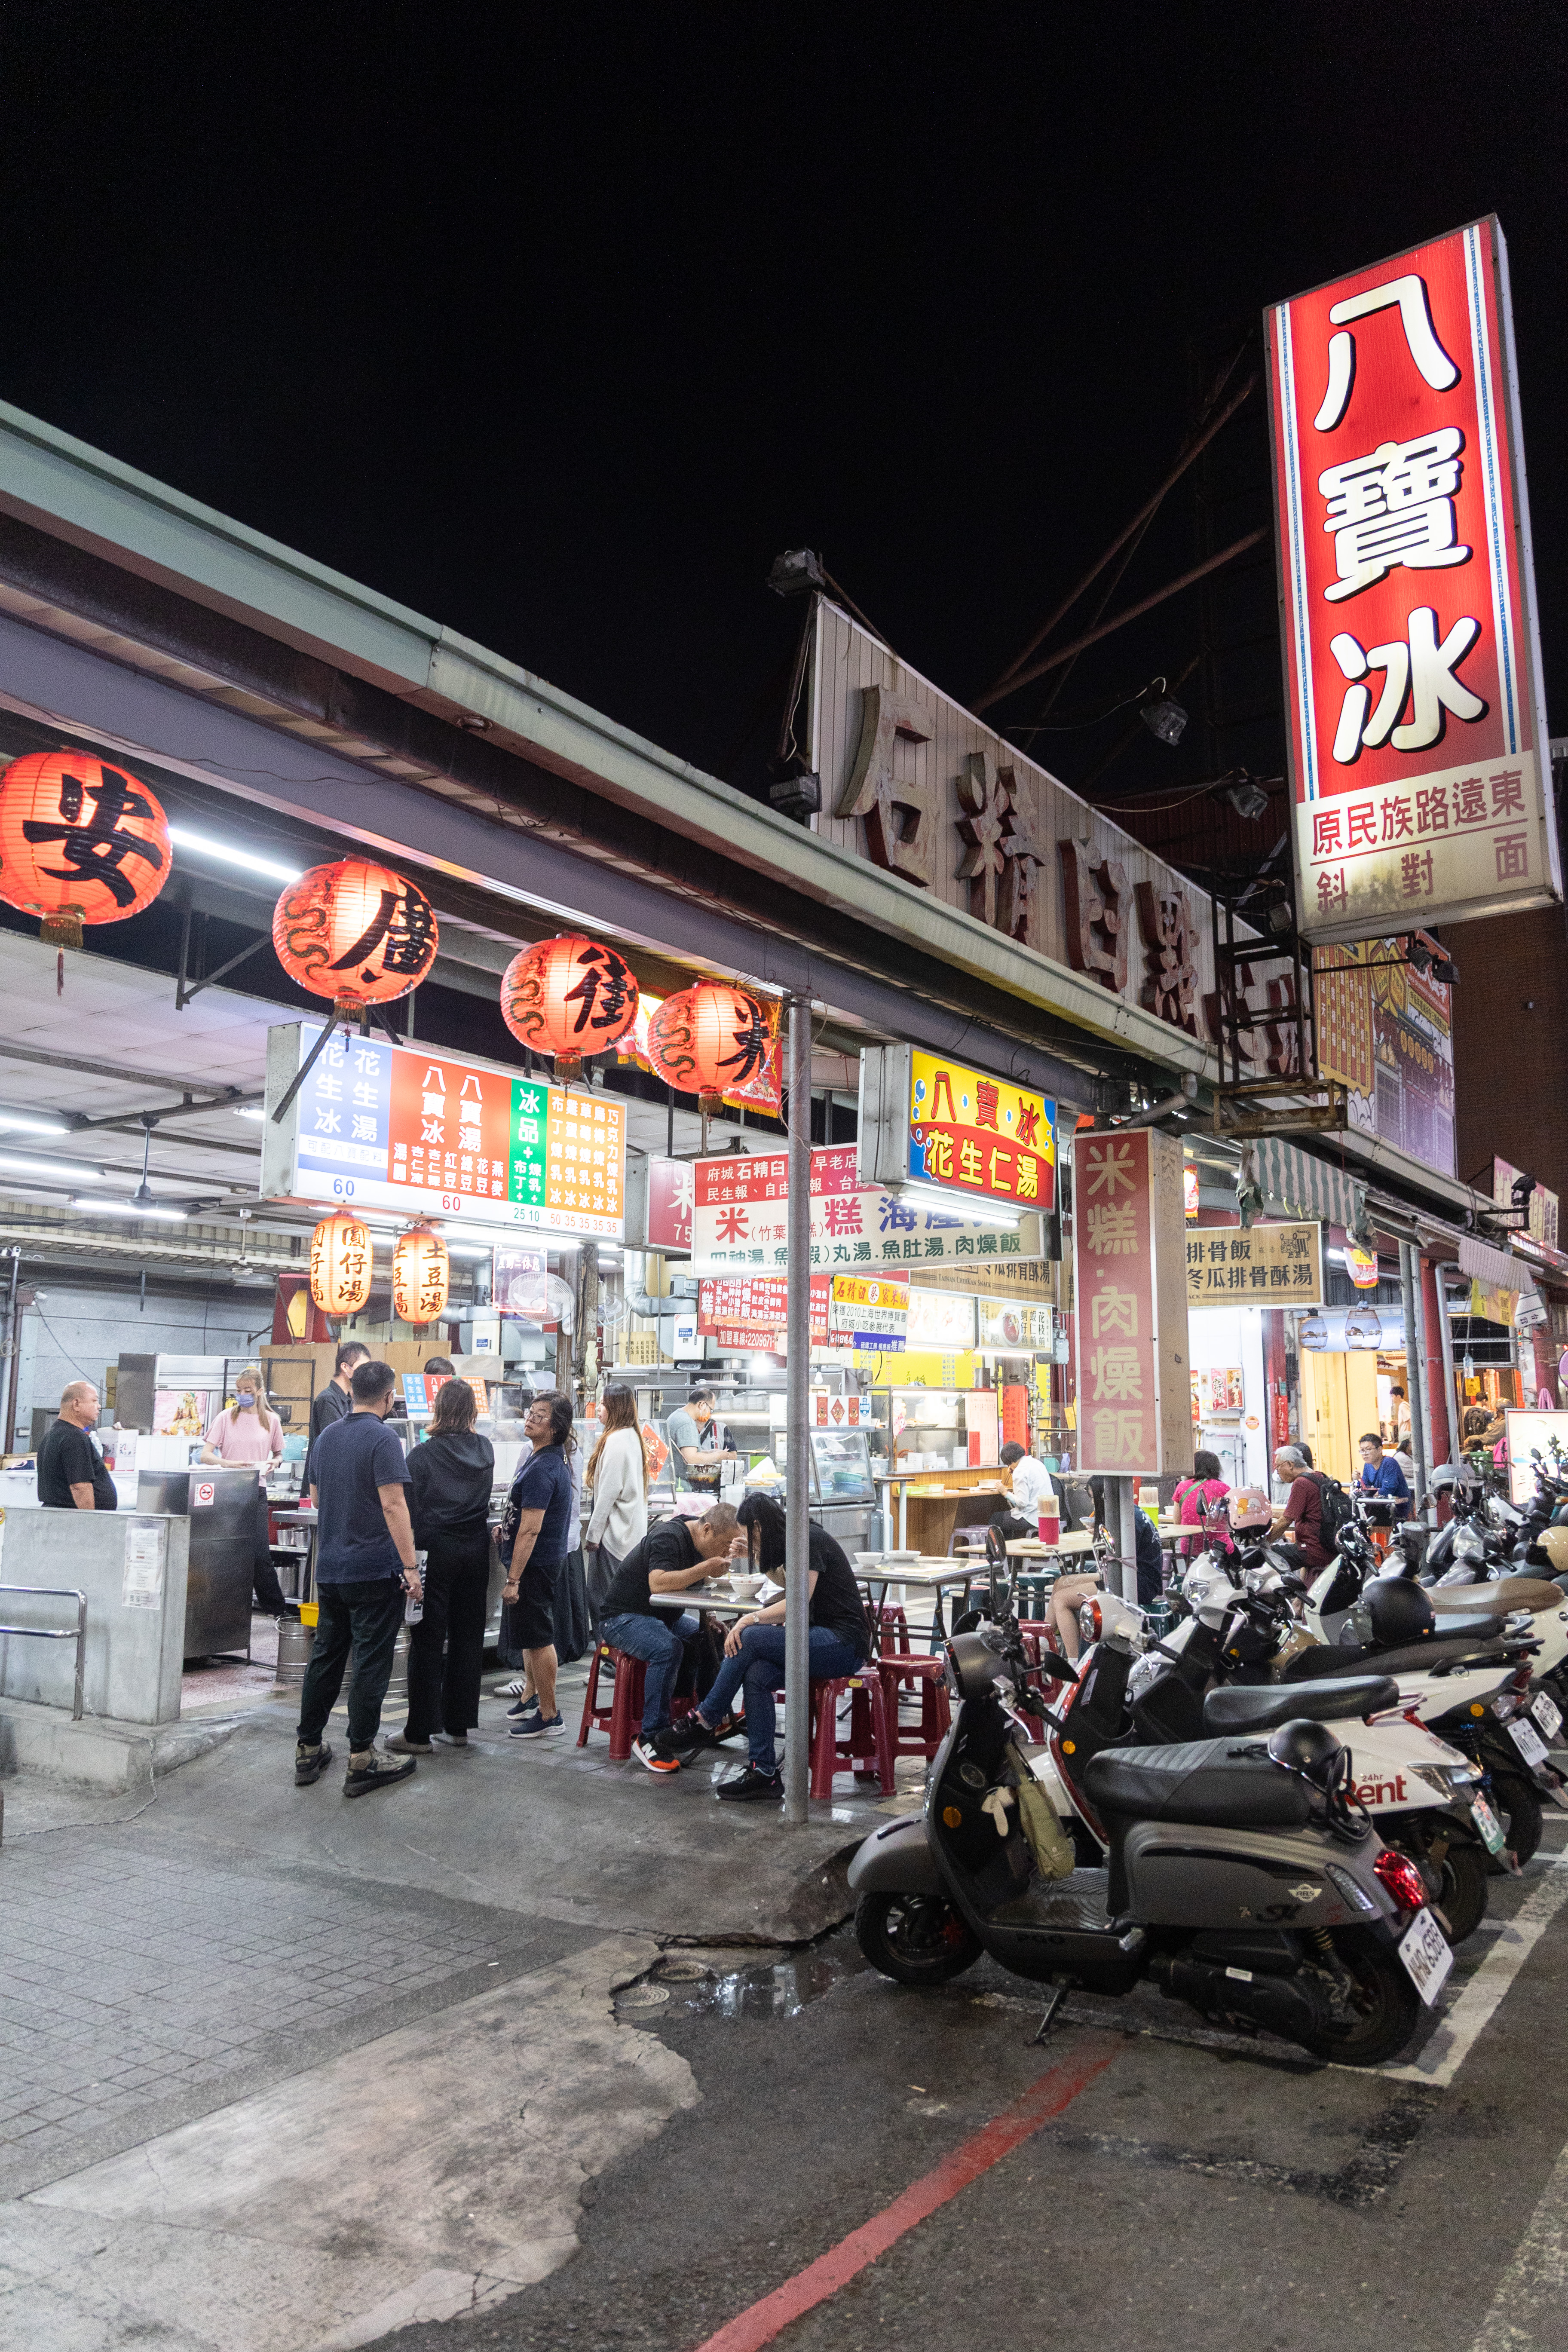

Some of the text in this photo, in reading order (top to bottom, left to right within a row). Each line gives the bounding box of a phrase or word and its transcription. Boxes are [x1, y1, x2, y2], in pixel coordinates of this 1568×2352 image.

[1313, 273, 1489, 766] 八寶冰
[22, 764, 164, 908] 安
[1311, 769, 1527, 856] 原民族路遠東
[1315, 833, 1529, 916] 斜對面
[314, 1040, 345, 1135] 花生冰
[351, 1047, 381, 1143] 花生湯
[420, 1065, 447, 1146] 八寶冰
[458, 1074, 483, 1153] 八寶湯
[931, 1072, 1040, 1147] 八寶冰
[334, 1179, 355, 1196] 60
[444, 1151, 457, 1189] 紅豆
[475, 1157, 488, 1194] 花豆
[928, 1129, 1039, 1198] 花生仁湯
[442, 1195, 461, 1211] 60
[514, 1207, 617, 1233] 25 10 50 35 35 35 35
[716, 1207, 750, 1244] 米
[825, 1197, 863, 1237] 糕
[338, 1226, 367, 1302] 圓仔湯
[420, 1241, 446, 1312] 土豆湯
[1186, 1240, 1251, 1264] 排骨飯
[1187, 1264, 1313, 1289] 冬瓜排骨酥湯
[1362, 1773, 1384, 1782] 24hr
